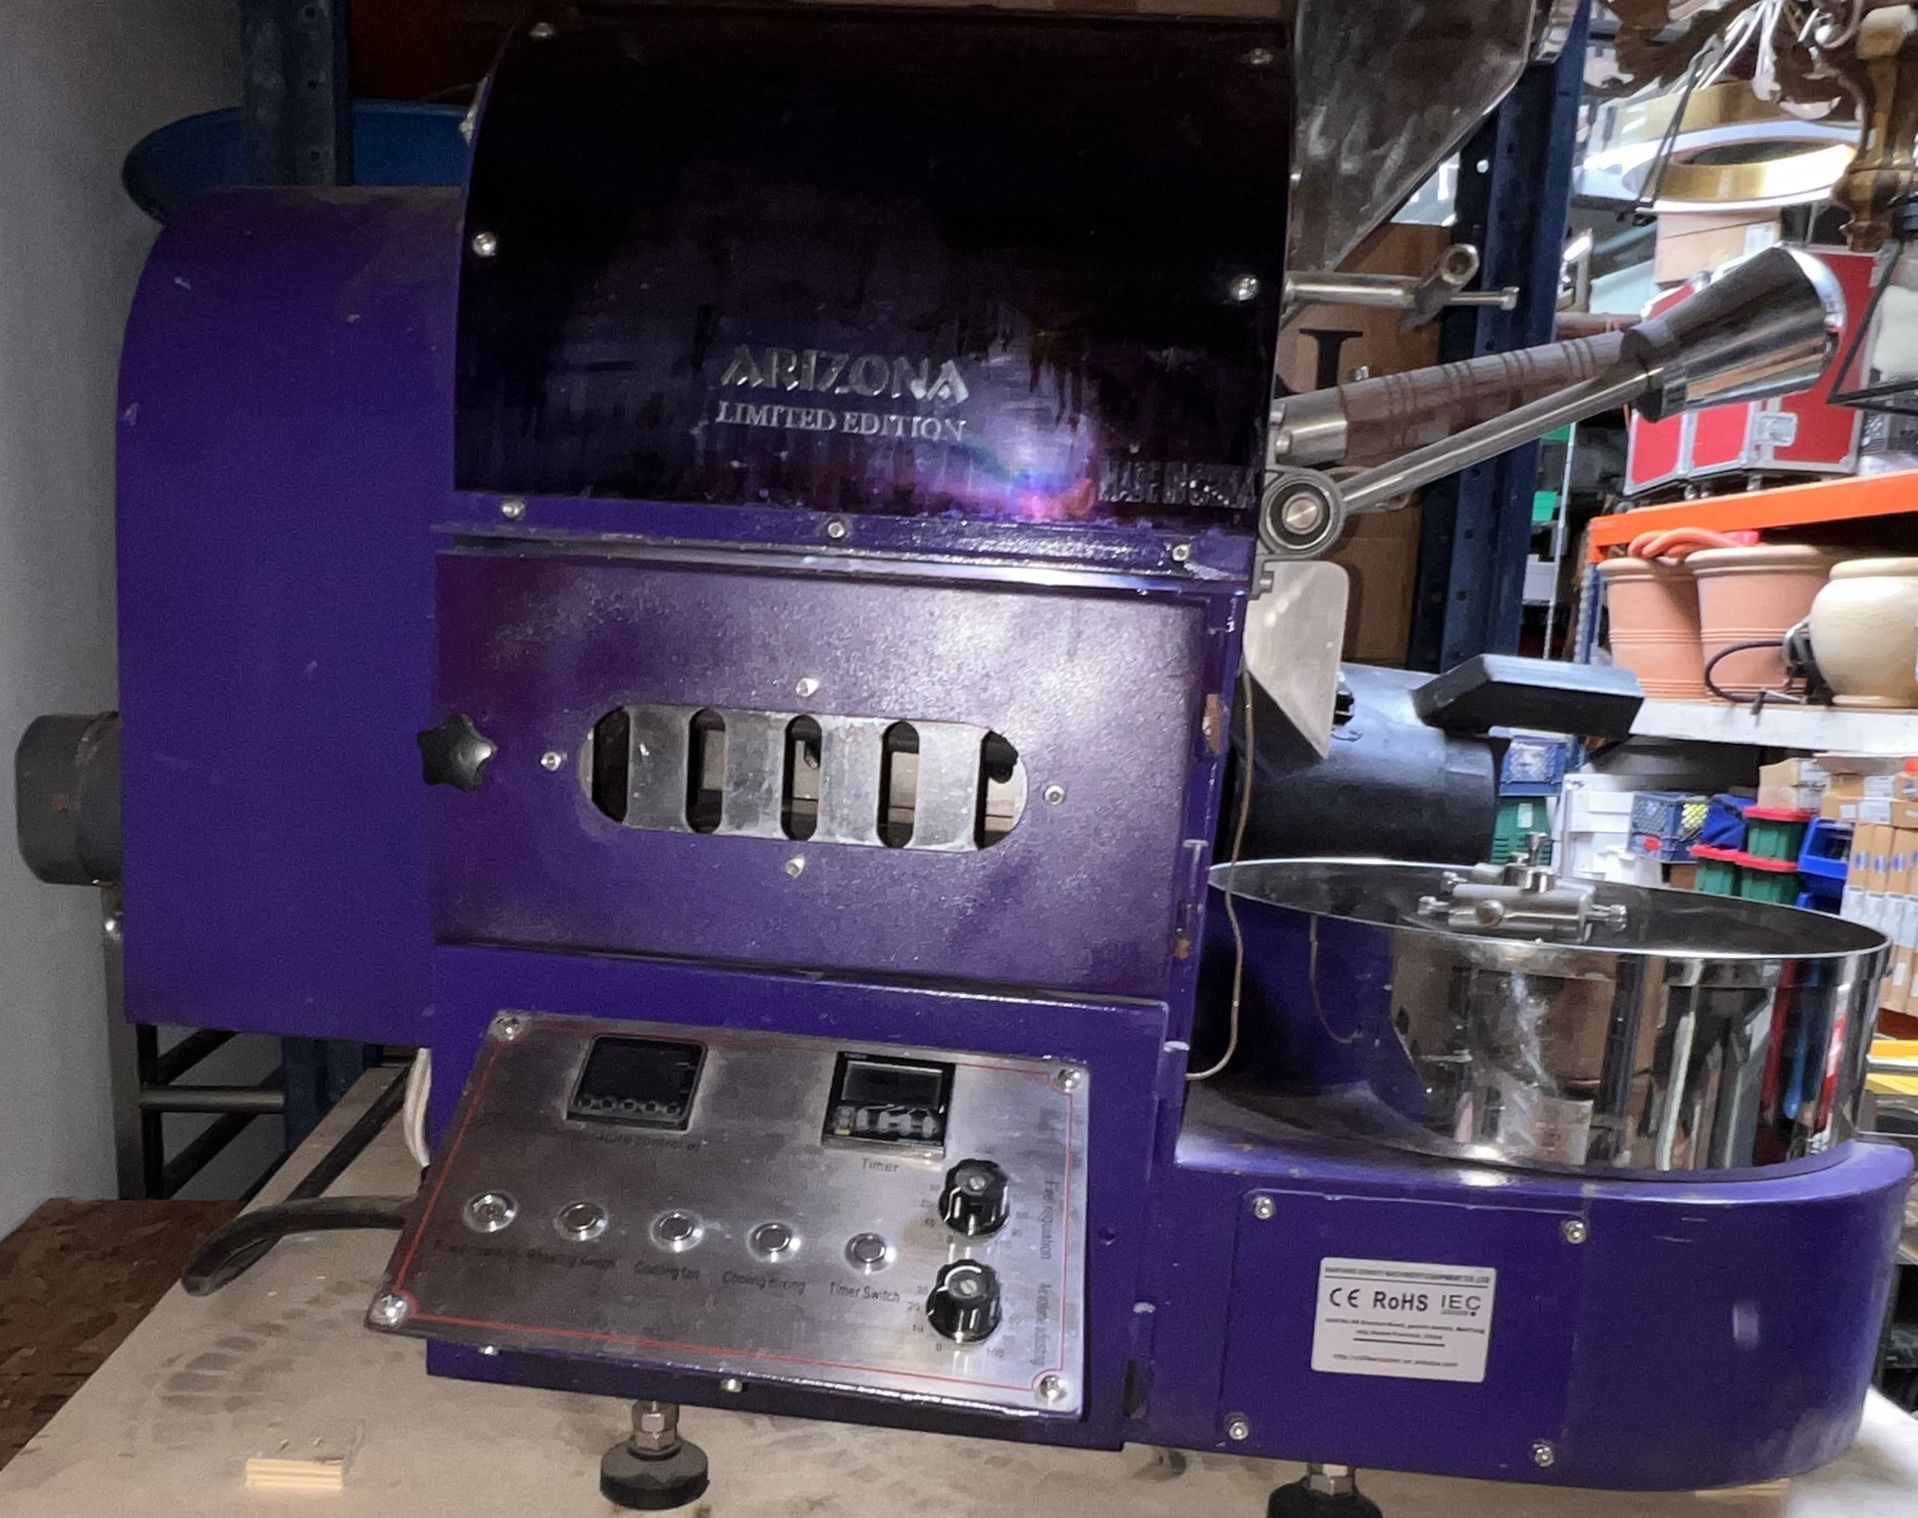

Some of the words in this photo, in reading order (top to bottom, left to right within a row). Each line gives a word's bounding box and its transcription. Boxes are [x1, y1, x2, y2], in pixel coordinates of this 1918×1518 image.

[720, 345, 969, 402] ARIZONA
[715, 401, 837, 432] LIMITED
[840, 411, 967, 442] EDITION
[861, 1157, 899, 1173] Timer
[829, 1281, 861, 1299] Timer
[863, 1285, 901, 1303] Switch
[1329, 1287, 1361, 1309] CE
[1373, 1291, 1429, 1312] RoHS
[1441, 1294, 1482, 1311] IEC
